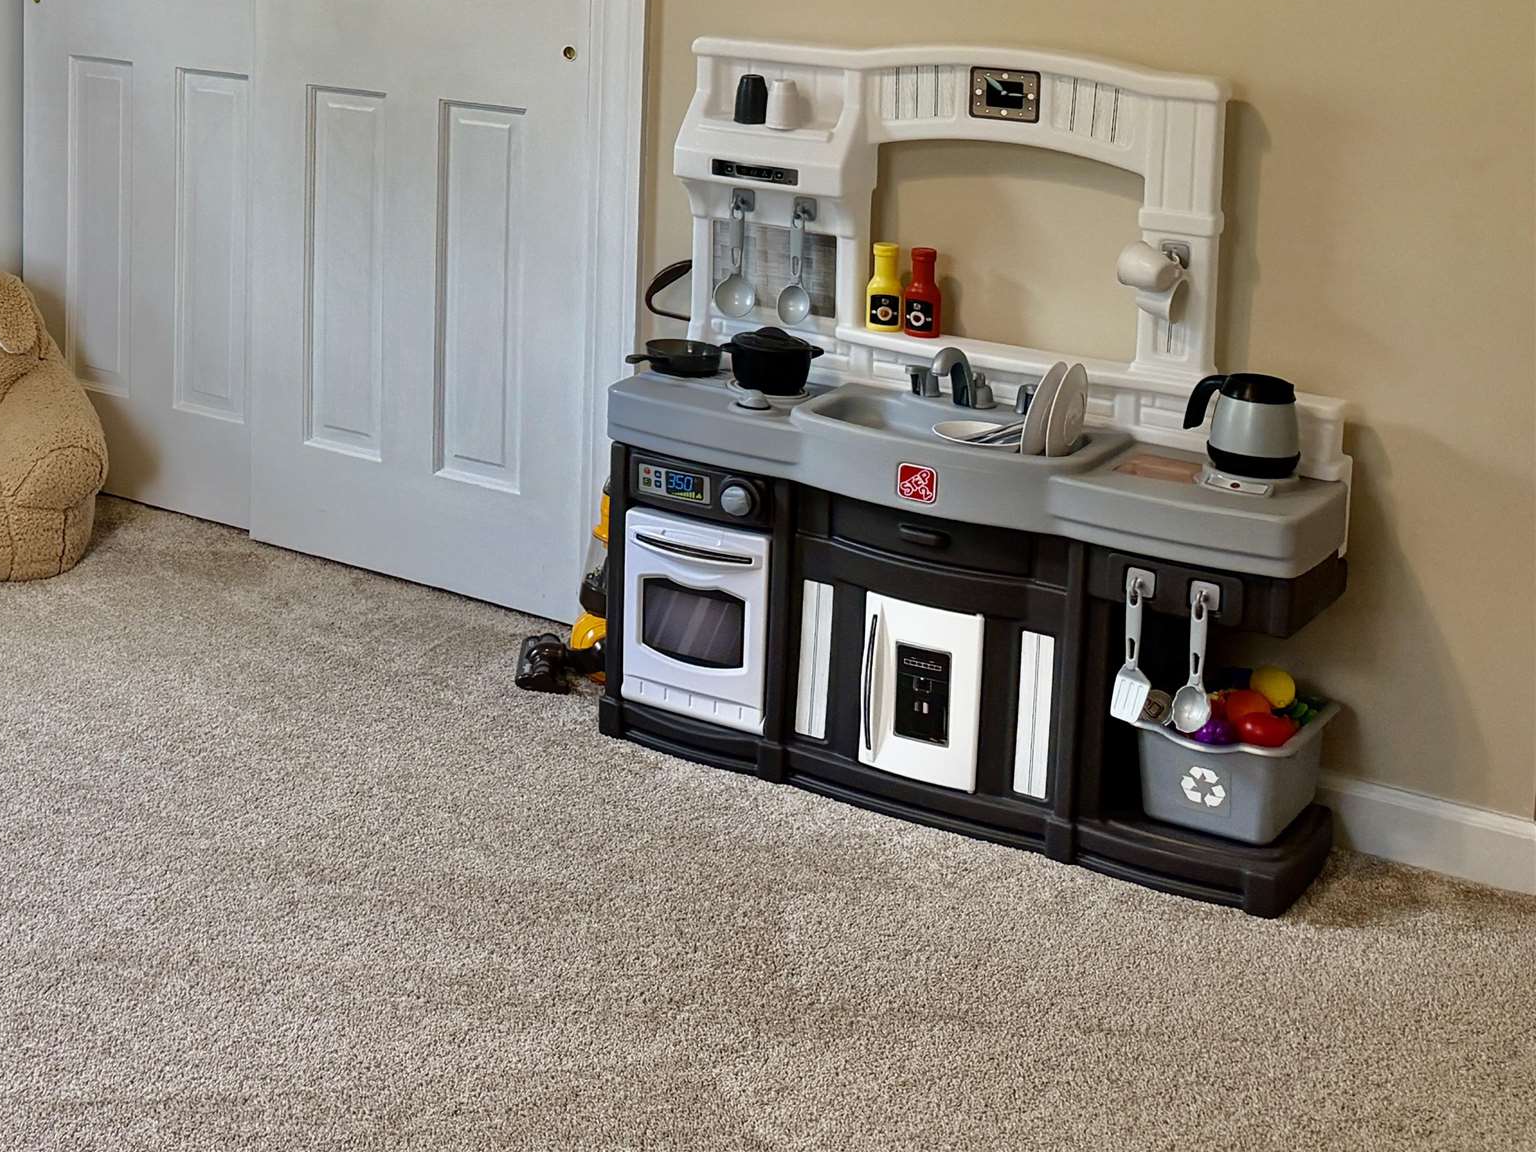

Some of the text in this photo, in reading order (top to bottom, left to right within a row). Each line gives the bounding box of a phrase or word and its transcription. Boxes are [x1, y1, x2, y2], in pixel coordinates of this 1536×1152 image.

[667, 472, 694, 492] 350
[900, 469, 931, 496] STEP
[918, 485, 933, 500] 2
